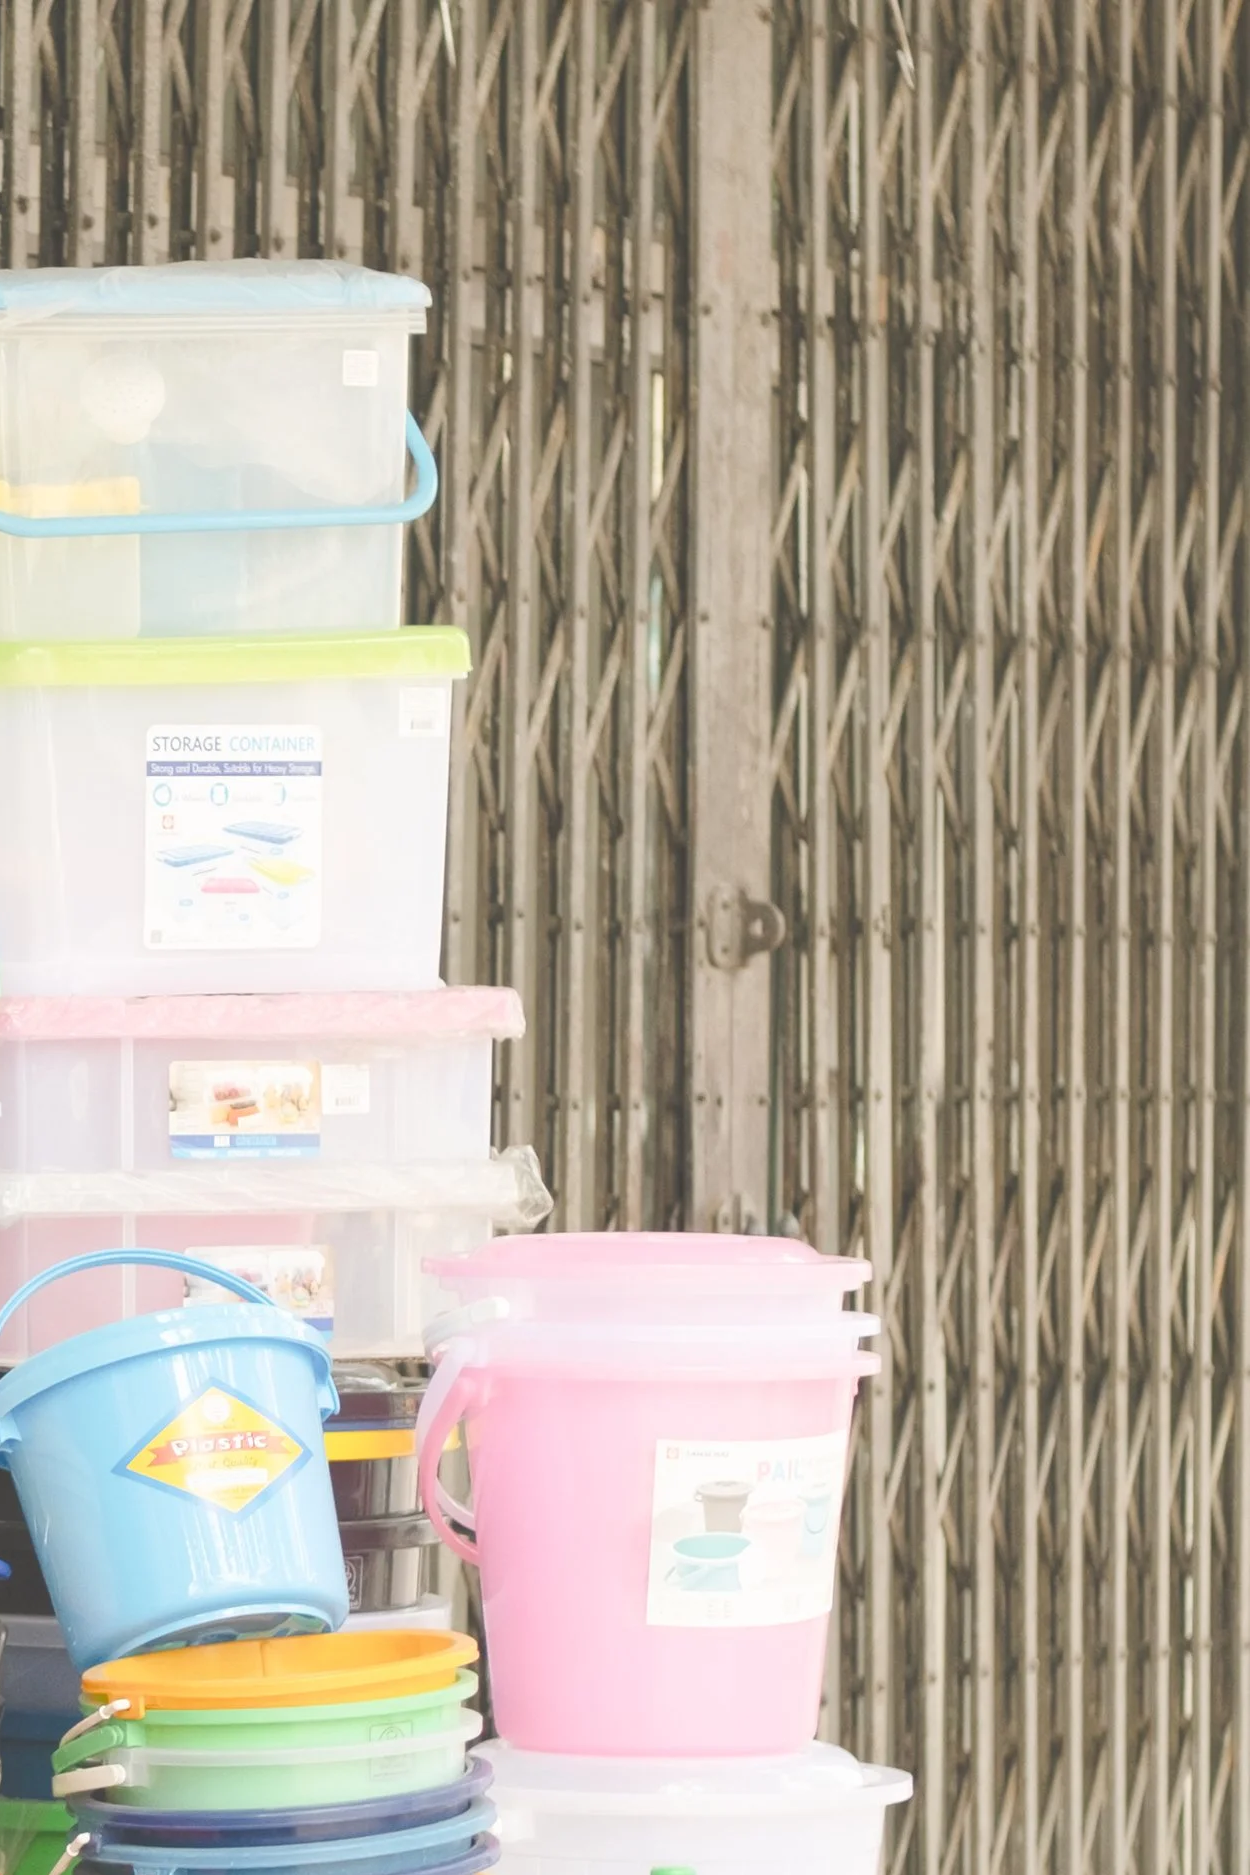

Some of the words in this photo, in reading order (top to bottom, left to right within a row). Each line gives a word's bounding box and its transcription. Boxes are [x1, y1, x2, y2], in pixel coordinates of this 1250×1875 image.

[152, 736, 222, 752] STORAGE
[228, 735, 315, 752] CONTAINER
[151, 763, 173, 775] Strong
[176, 763, 190, 774] and
[252, 763, 262, 775] for
[264, 763, 286, 775] Heavy
[170, 1431, 269, 1458] Plastic
[756, 1458, 805, 1483] PAIL
